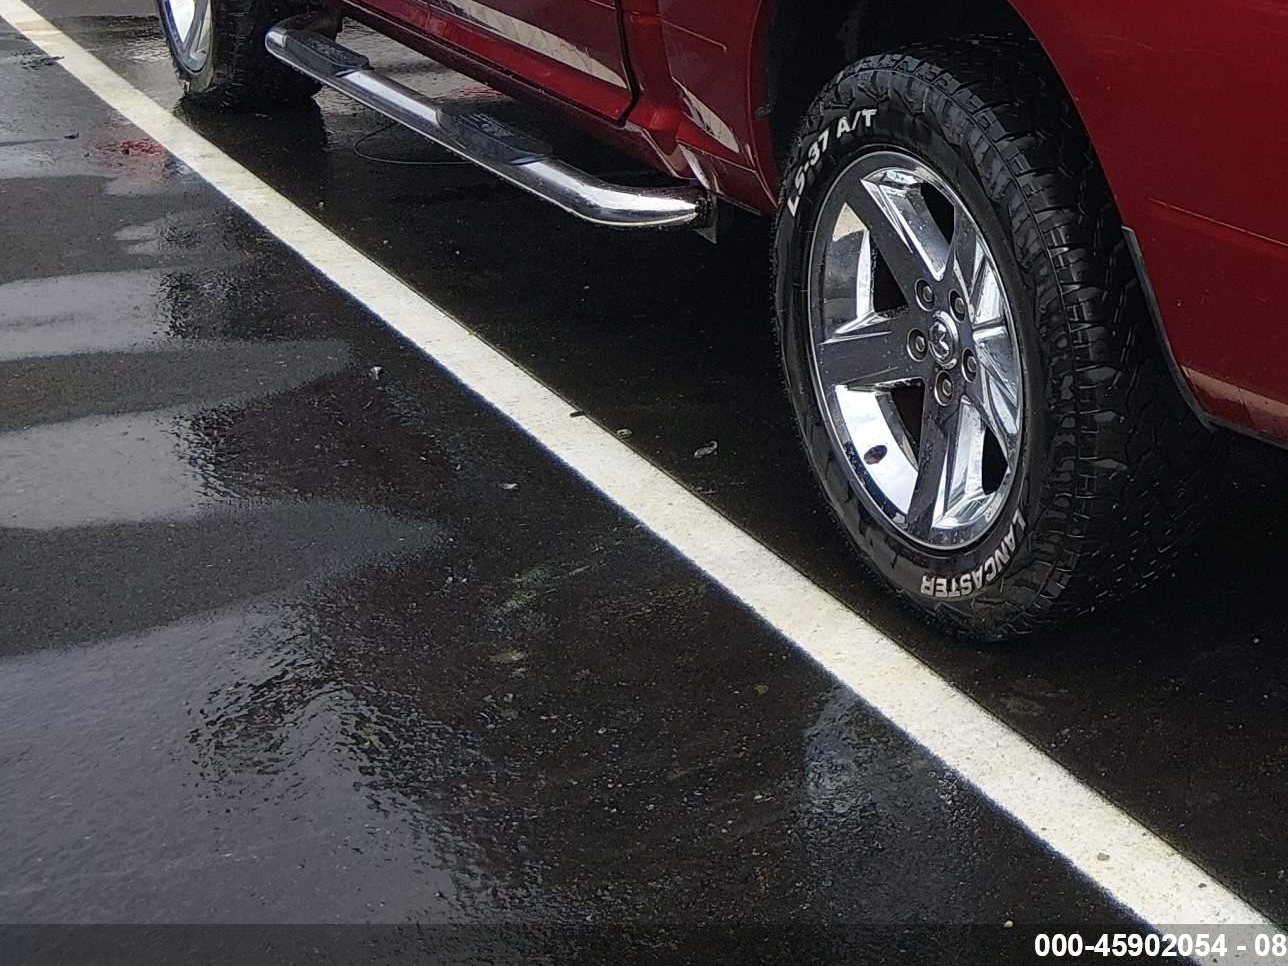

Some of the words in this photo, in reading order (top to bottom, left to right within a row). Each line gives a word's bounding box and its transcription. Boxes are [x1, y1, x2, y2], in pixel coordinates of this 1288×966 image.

[786, 127, 830, 218] LS-37
[836, 108, 878, 139] A/T
[920, 507, 1027, 599] LANCASTER
